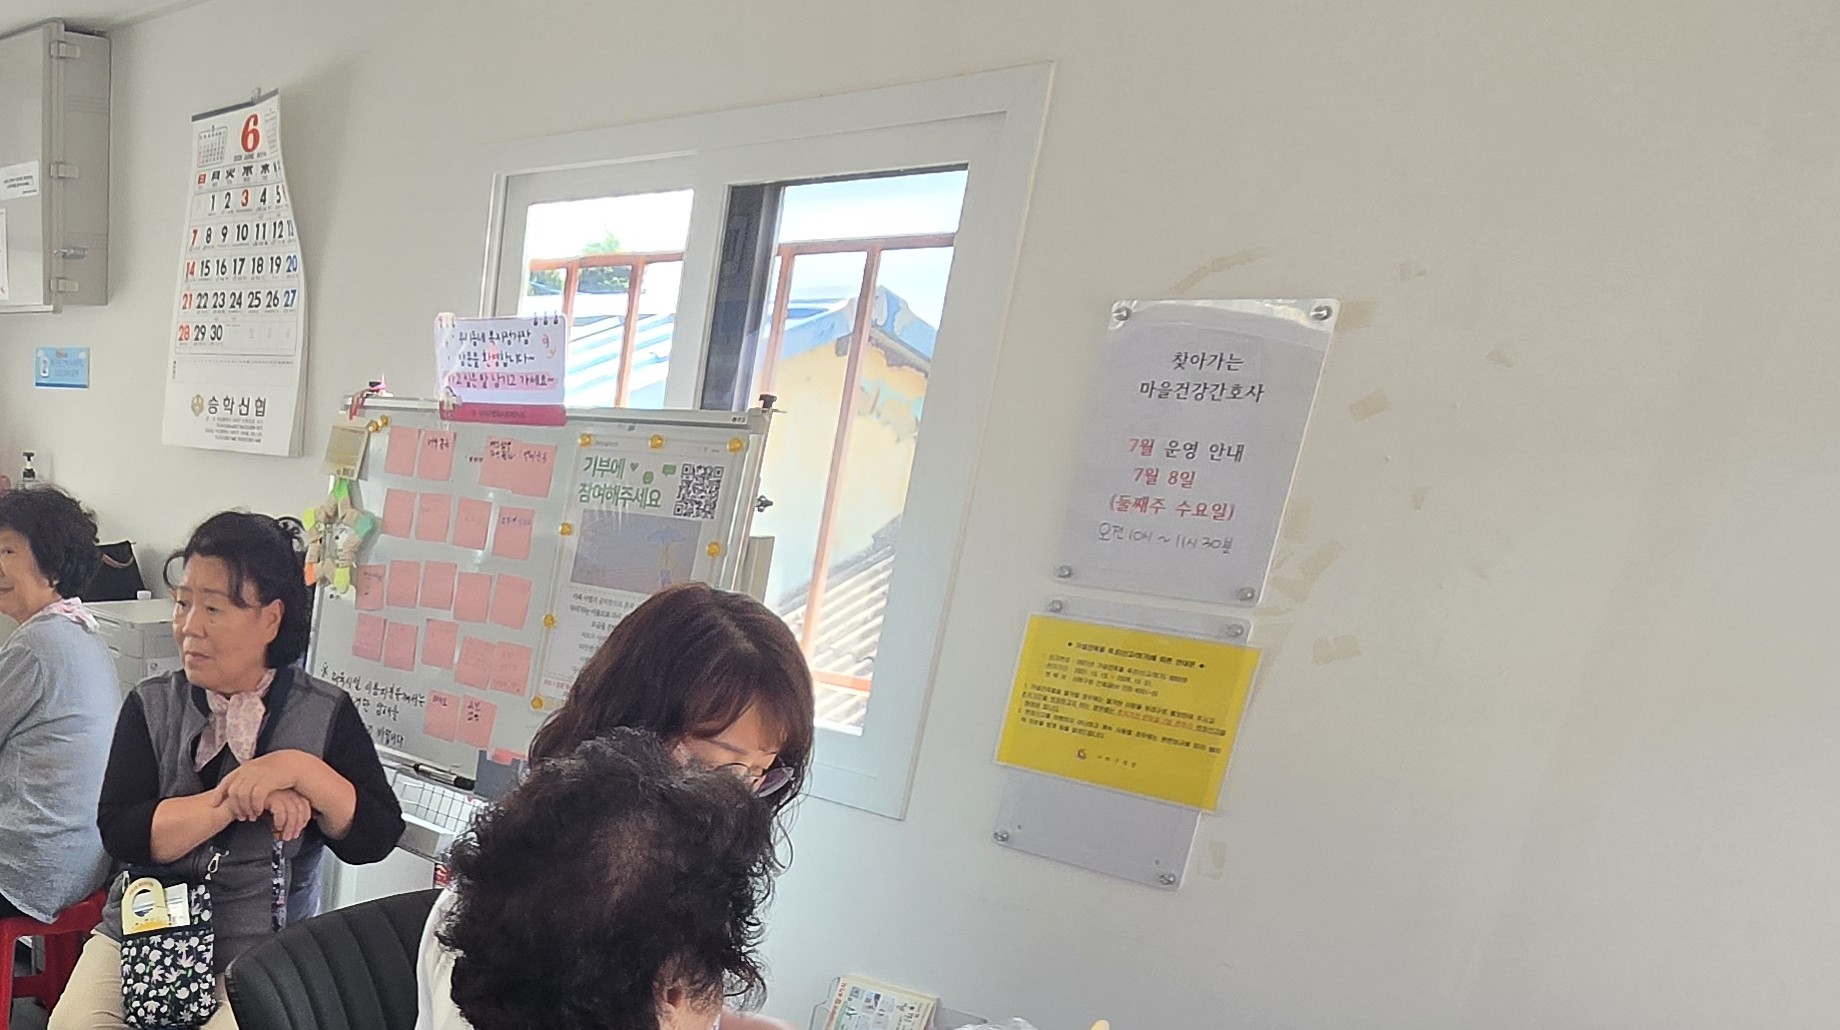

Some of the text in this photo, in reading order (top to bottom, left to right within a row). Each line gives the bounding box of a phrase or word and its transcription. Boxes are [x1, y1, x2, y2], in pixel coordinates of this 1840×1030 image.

[241, 113, 260, 153] 6
[211, 185, 282, 211] 1 2 3 4 5
[191, 229, 198, 246] 7
[205, 227, 212, 244] 8
[221, 225, 228, 243] 9
[236, 223, 249, 241] 10
[255, 222, 266, 240] 11
[272, 220, 284, 239] 12
[200, 259, 211, 277] 15
[216, 258, 227, 275] 16
[233, 257, 245, 275] 17
[252, 256, 264, 274] 18
[270, 255, 281, 274] 19
[286, 254, 298, 273] 20
[182, 289, 297, 310] 21 22 23 24 25 26 27
[178, 324, 223, 341] 28 29 30
[1172, 351, 1244, 372] 찾아가는
[1139, 380, 1265, 403] 마을건강간호사
[207, 395, 266, 417] 승학신협
[1129, 437, 1245, 463] 7월 운영 안내
[583, 455, 626, 479] 기부에
[1133, 467, 1196, 489] 7월 8일
[577, 482, 662, 509] 참여해주세요
[1109, 494, 1235, 521] (둘째주 수요일)
